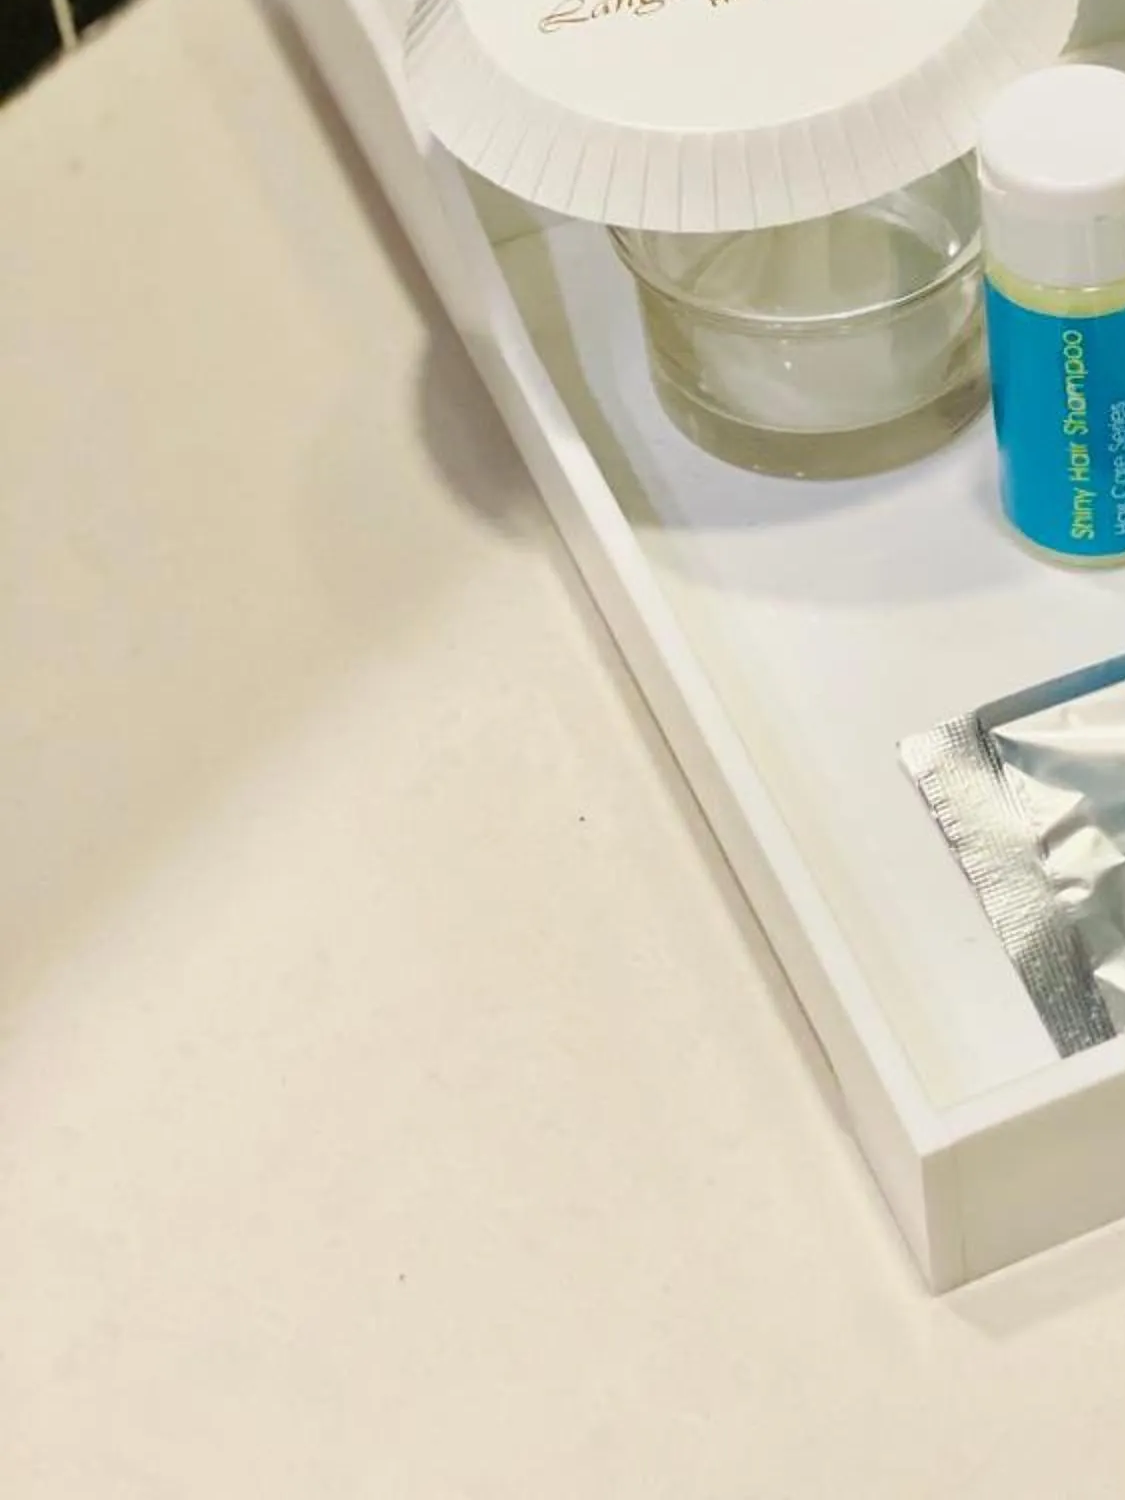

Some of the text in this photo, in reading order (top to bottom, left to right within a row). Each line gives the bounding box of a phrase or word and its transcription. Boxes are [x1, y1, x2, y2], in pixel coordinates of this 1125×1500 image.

[1062, 329, 1096, 540] Shiny Hair Shampoo
